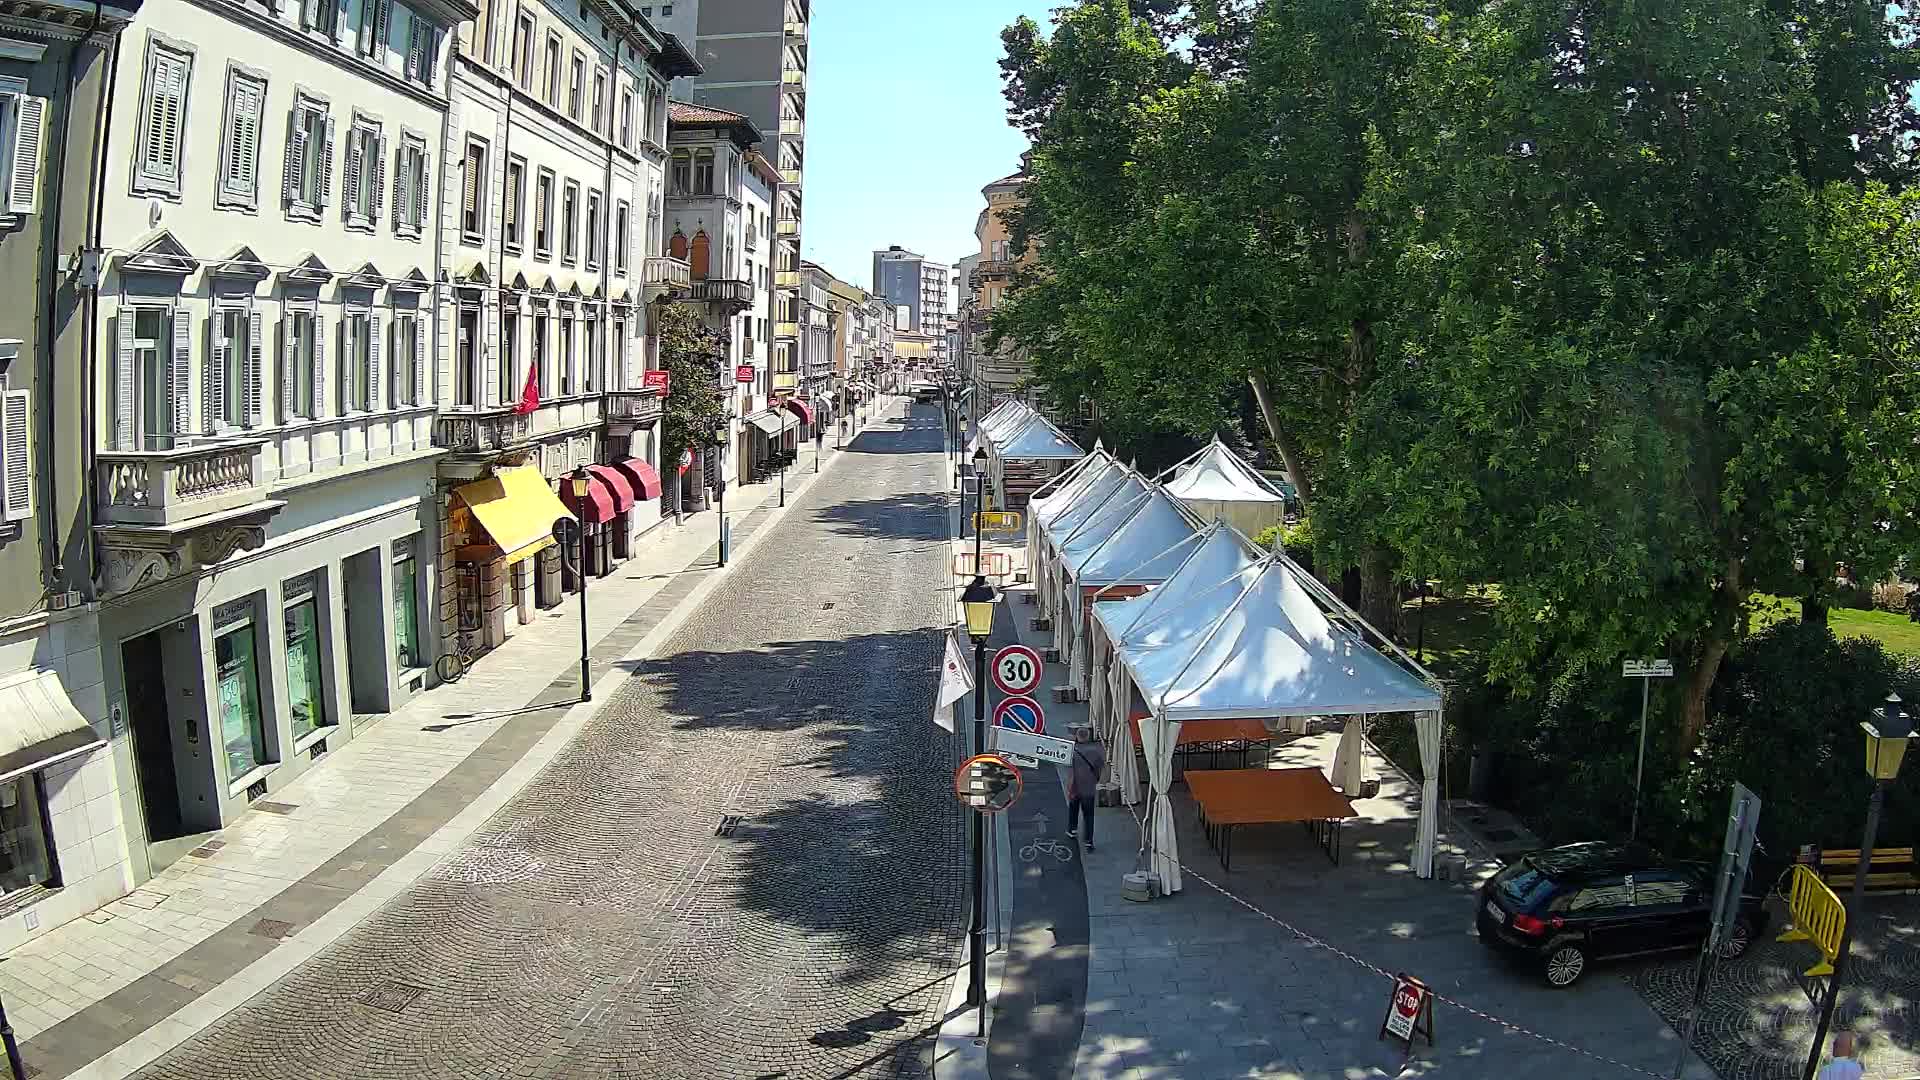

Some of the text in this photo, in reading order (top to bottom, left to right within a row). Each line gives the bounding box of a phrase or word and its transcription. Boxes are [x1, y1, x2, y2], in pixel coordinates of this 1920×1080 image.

[1004, 660, 1031, 682] 30
[1036, 745, 1066, 760] Dante
[1397, 990, 1418, 1011] STOP
